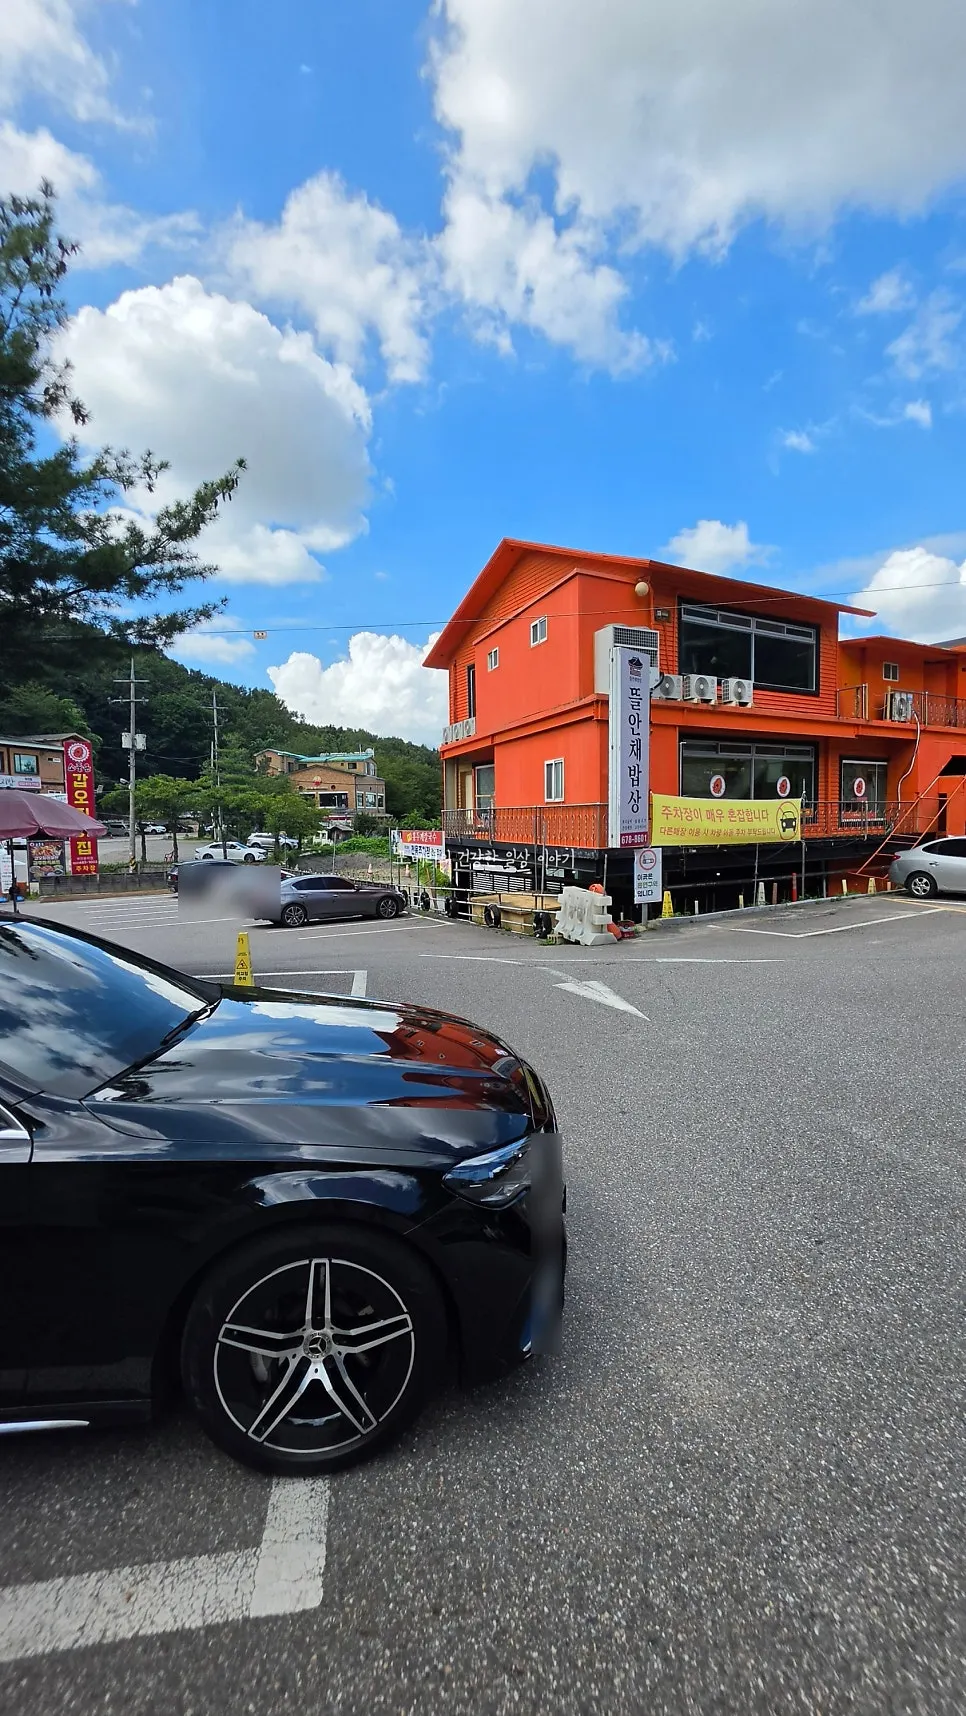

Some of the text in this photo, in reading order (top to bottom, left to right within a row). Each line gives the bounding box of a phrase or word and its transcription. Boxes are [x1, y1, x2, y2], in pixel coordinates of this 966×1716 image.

[628, 687, 643, 814] 뜰안채밥상
[72, 773, 93, 855] 갑오집
[661, 805, 770, 823] 주차장이 매우 혼잡합니다
[506, 847, 530, 869] 일상
[537, 848, 575, 869] 이야기
